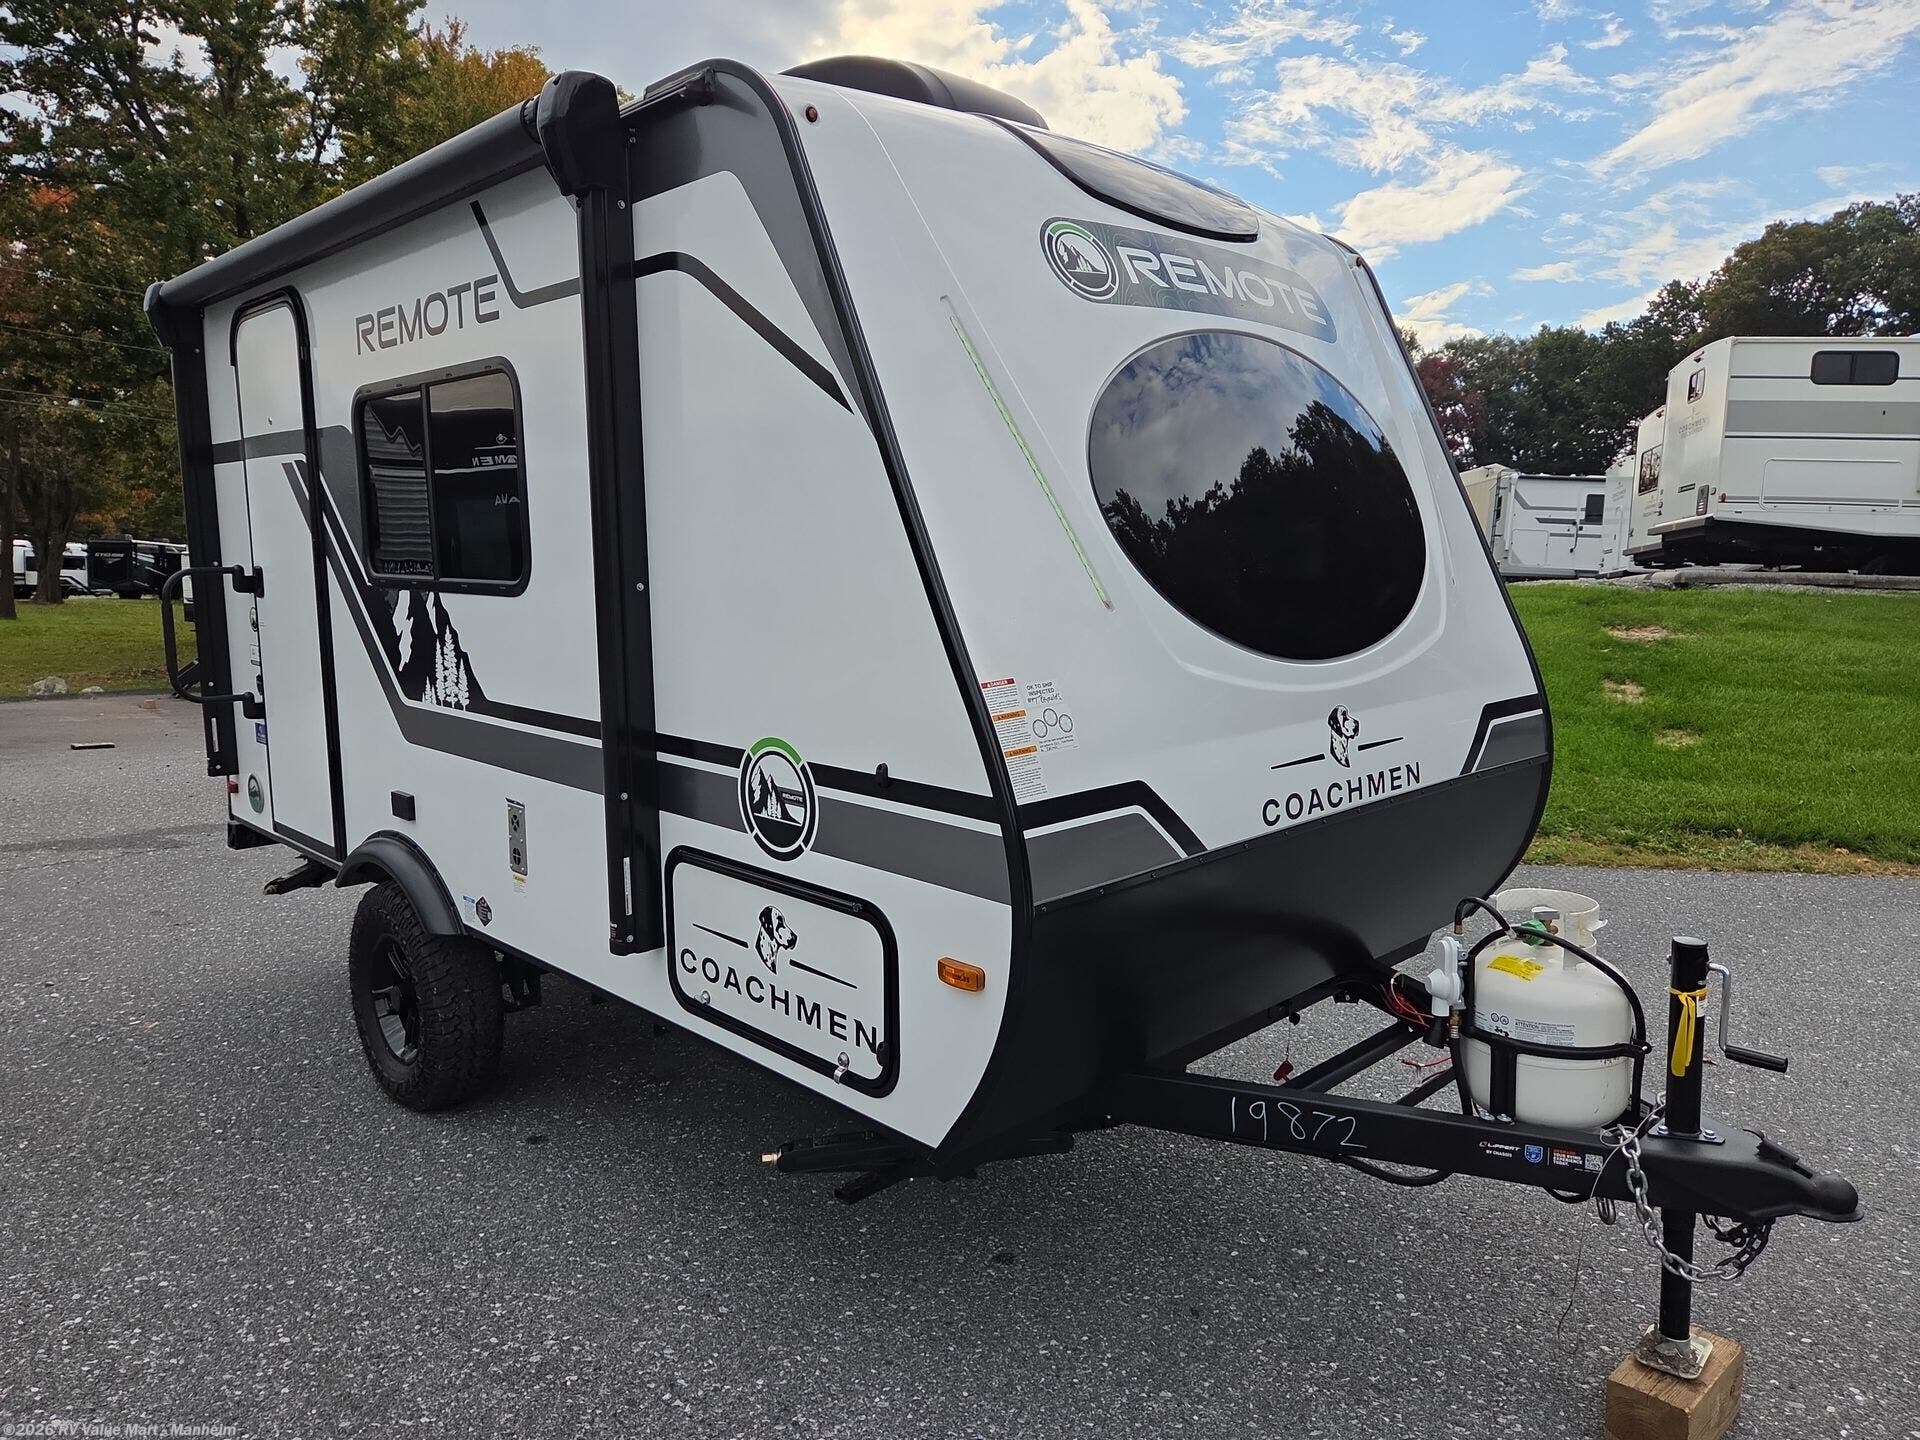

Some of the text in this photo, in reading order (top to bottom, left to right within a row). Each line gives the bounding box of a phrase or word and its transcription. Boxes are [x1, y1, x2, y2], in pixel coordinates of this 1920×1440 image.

[355, 274, 500, 355] REMOTE
[1116, 246, 1326, 325] REMOTE
[782, 792, 803, 802] REMOTE
[1262, 761, 1421, 826] COACHMEN
[680, 948, 878, 1055] COACHMEN
[1231, 1096, 1368, 1148] 19872
